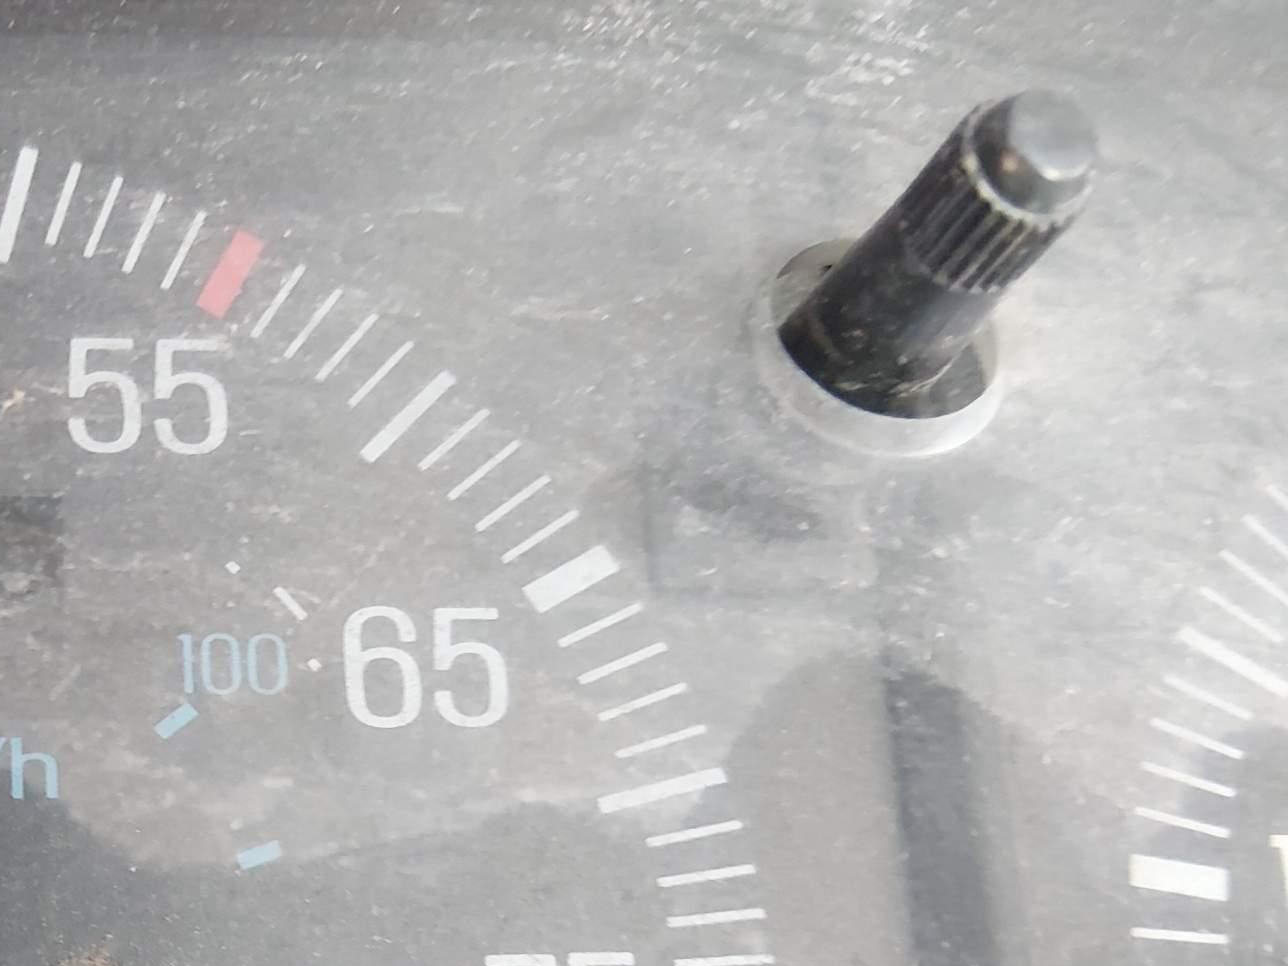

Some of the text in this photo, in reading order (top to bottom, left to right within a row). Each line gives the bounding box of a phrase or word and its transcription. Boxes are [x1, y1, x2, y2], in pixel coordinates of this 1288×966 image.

[66, 337, 229, 455] 55
[176, 632, 289, 696] 100
[342, 605, 509, 729] 65
